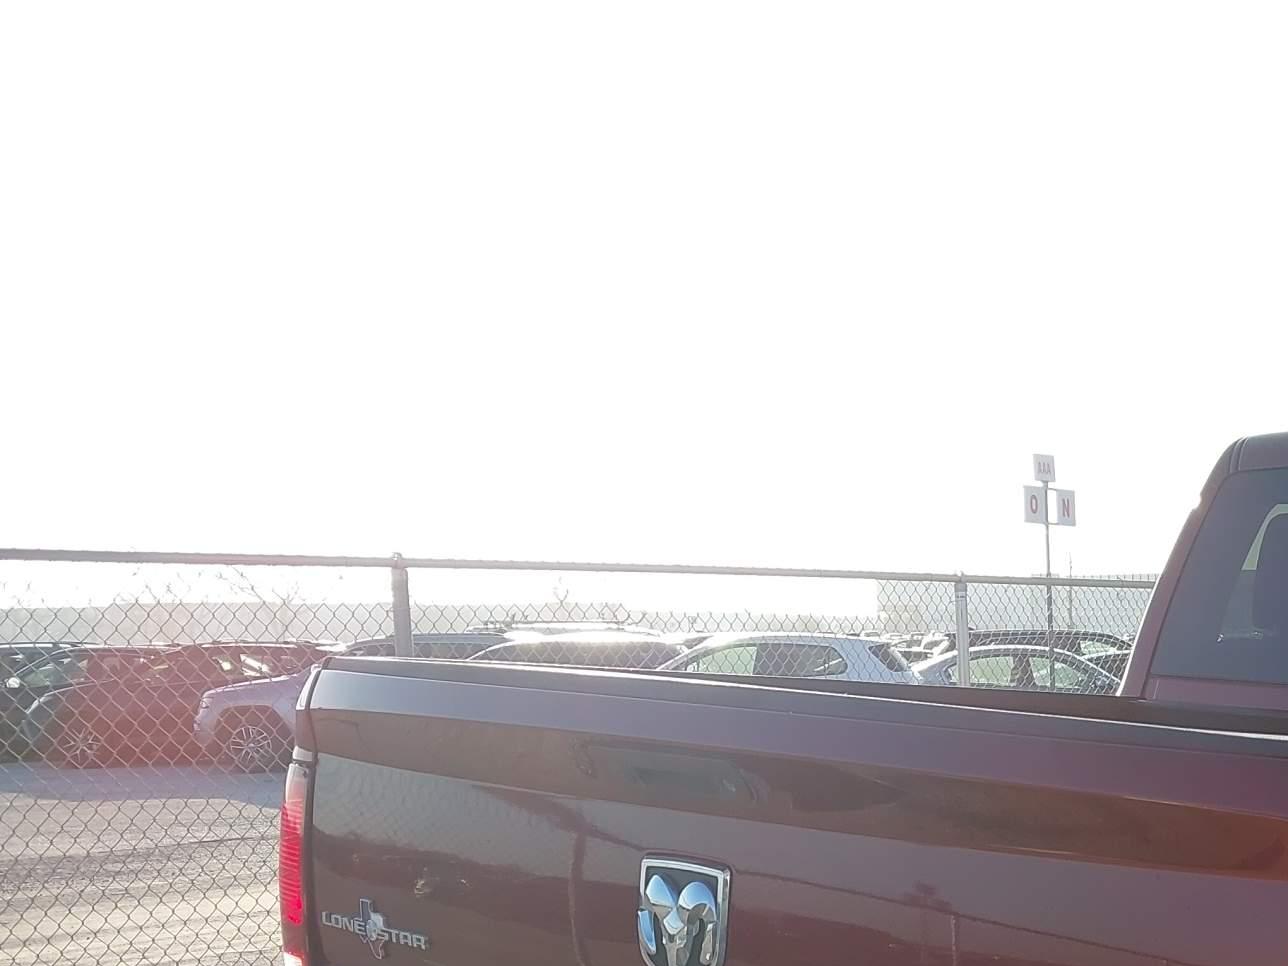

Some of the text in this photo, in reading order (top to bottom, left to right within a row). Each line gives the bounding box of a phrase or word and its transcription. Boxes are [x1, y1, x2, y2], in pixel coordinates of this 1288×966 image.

[1062, 498, 1070, 518] N
[321, 911, 426, 951] LONE STAR
